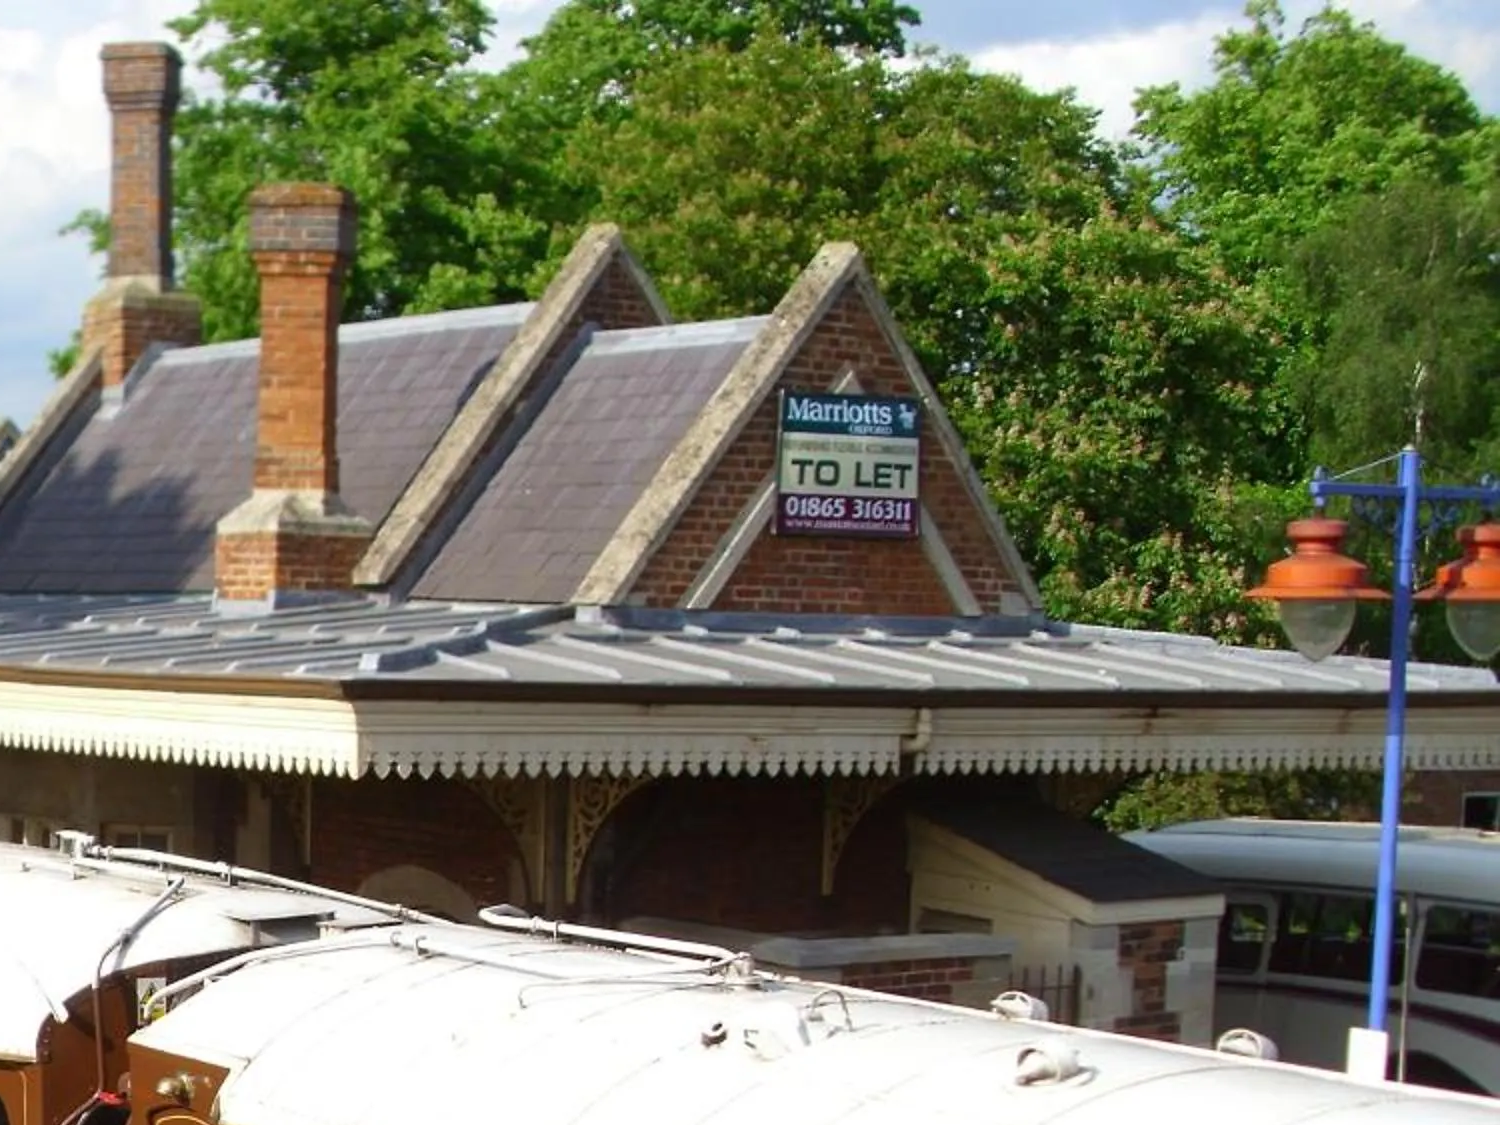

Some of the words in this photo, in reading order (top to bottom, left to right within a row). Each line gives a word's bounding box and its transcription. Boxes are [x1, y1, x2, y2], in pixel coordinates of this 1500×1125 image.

[787, 398, 892, 425] Marriotts
[791, 459, 840, 486] TO
[855, 461, 912, 489] LET
[785, 496, 845, 518] 01865
[852, 499, 911, 521] 316311
